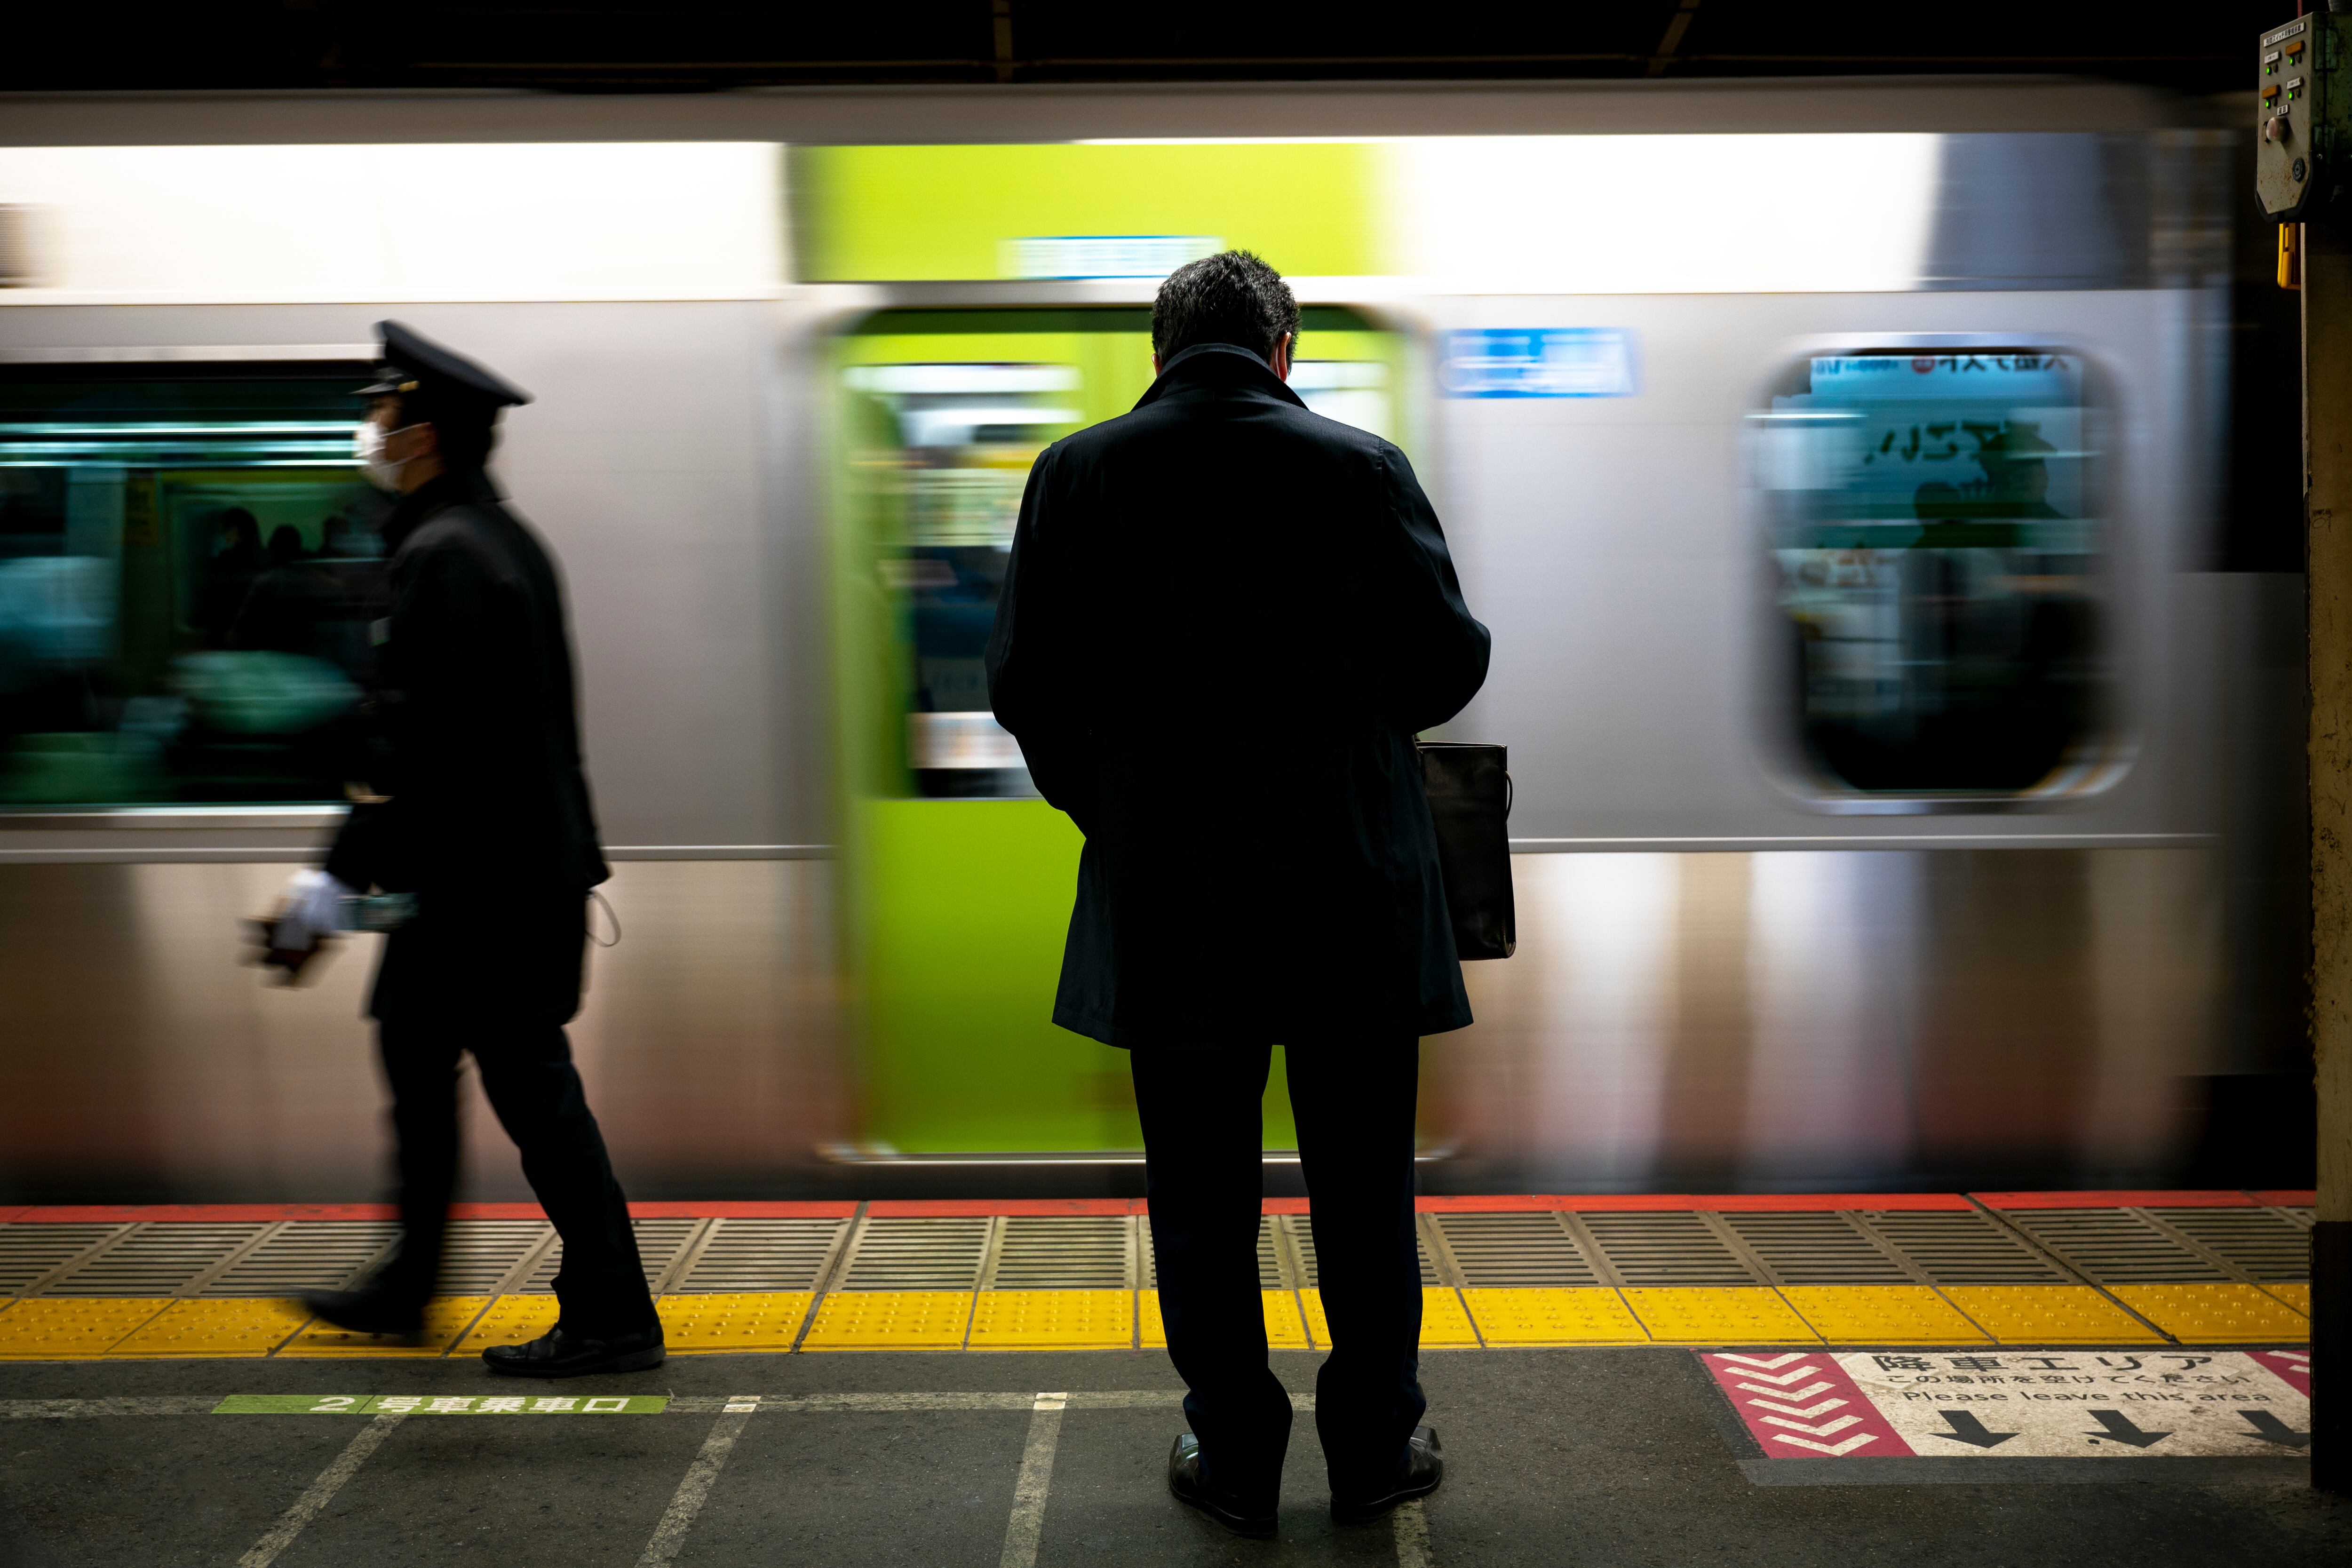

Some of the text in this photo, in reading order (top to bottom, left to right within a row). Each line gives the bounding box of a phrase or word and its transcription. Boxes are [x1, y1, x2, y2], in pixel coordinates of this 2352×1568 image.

[1872, 1355, 2212, 1371] 降車エリア
[1887, 1375, 2251, 1384] この場所を空けてください
[1903, 1392, 2008, 1401] Please
[2020, 1392, 2110, 1401] leave
[2121, 1392, 2185, 1401] this
[310, 1397, 630, 1413] 2号車乗車口
